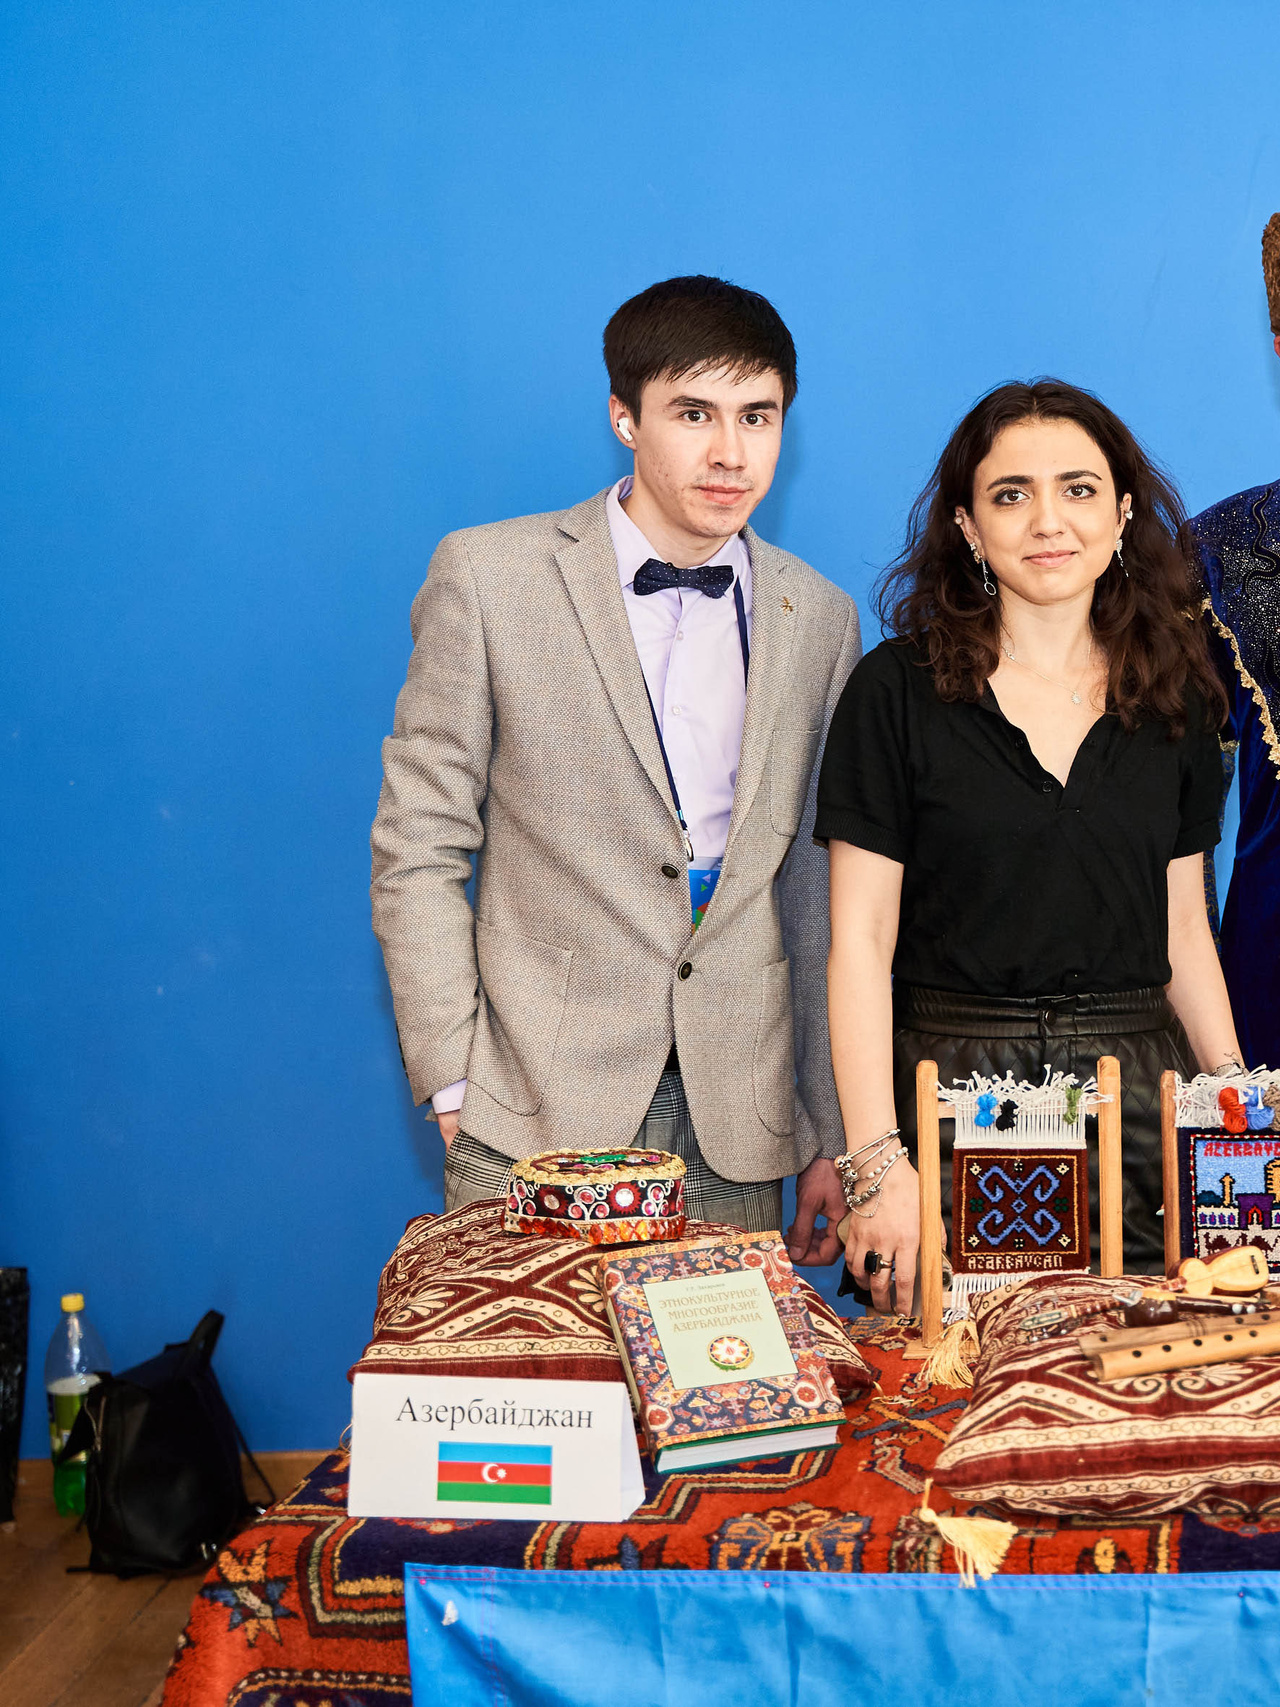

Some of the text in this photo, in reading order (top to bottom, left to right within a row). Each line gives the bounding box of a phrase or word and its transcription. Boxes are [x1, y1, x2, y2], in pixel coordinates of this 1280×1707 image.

[659, 1287, 760, 1310] ЭТНОКУЛЬТУРНОЕ
[668, 1300, 758, 1320] МНОГООБРАЗИЕ
[673, 1312, 763, 1333] АЗЕРБАЙДЖАНА
[395, 1396, 593, 1431] Азербайджан
